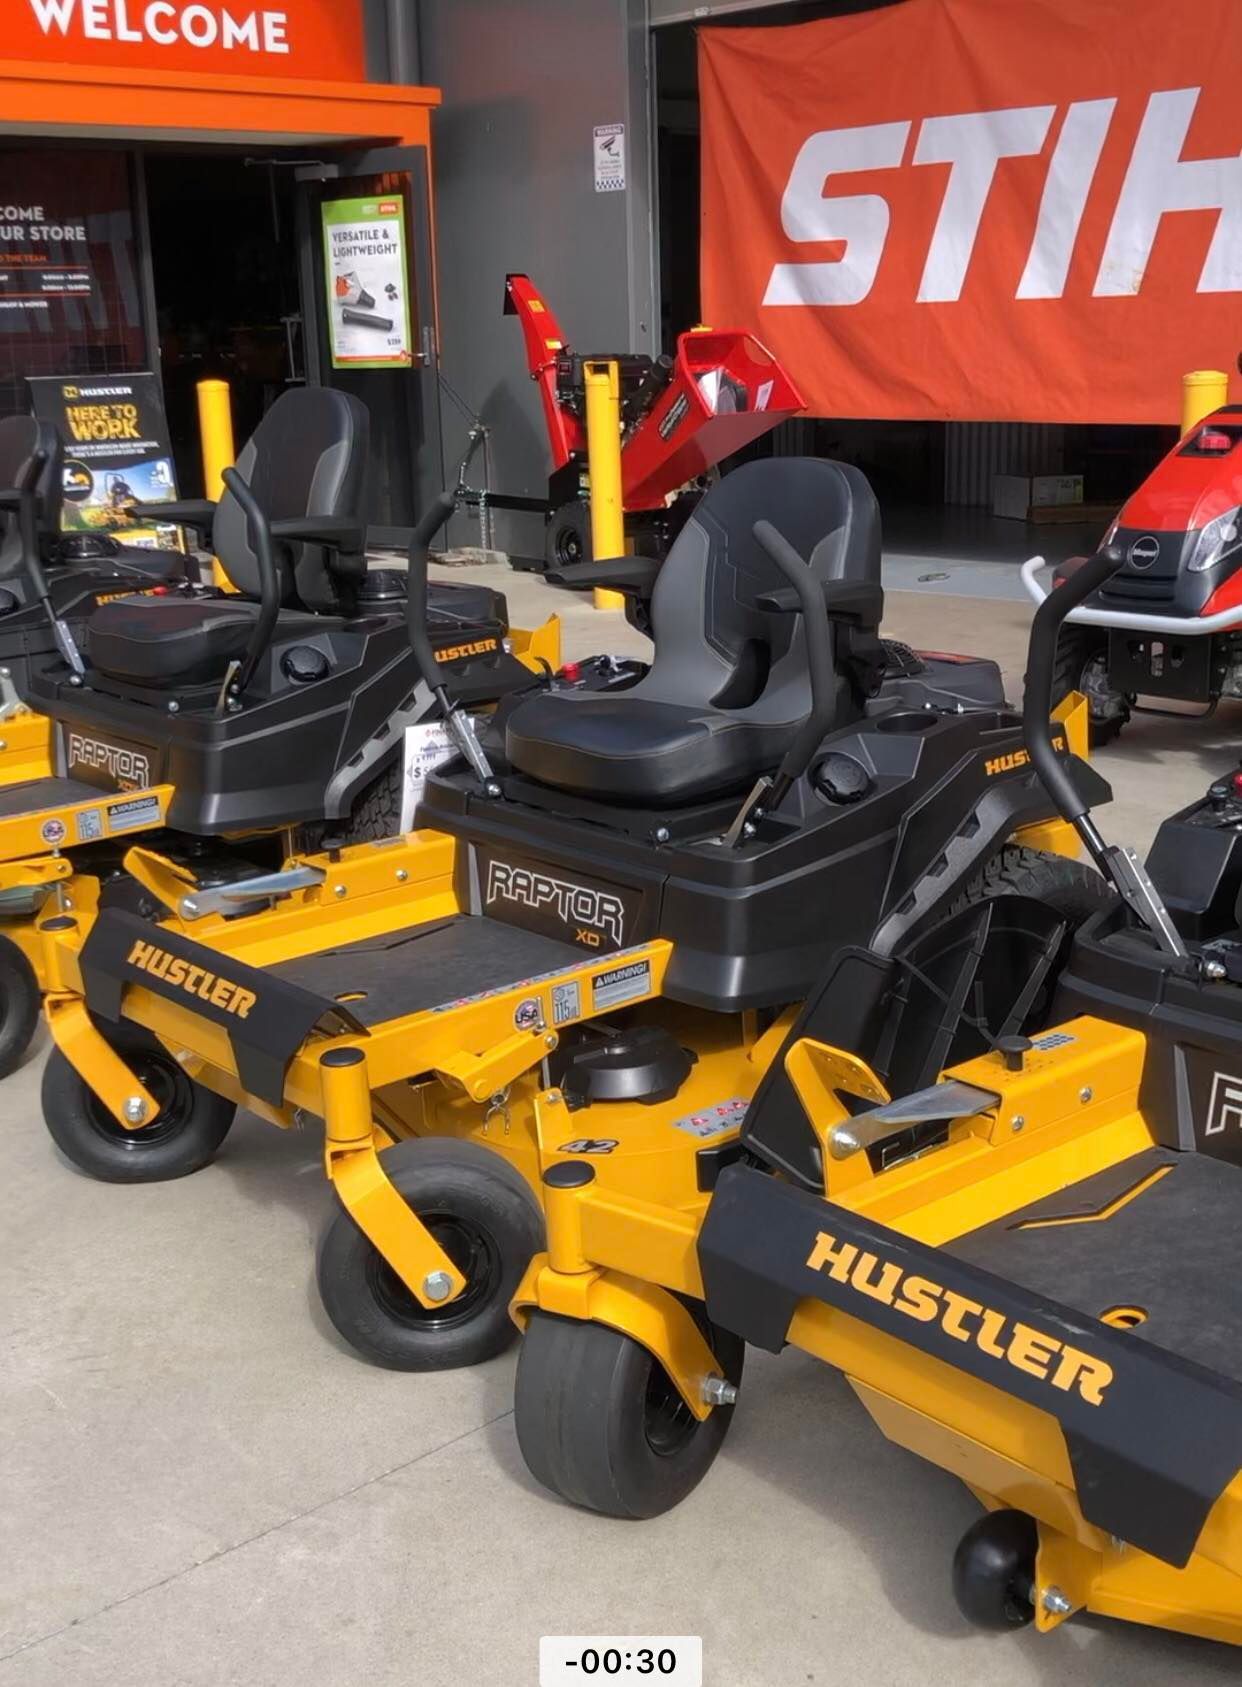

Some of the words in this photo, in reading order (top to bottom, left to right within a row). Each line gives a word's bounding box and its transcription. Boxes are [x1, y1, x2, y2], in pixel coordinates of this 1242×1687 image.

[27, 0, 289, 53] WELCOME
[762, 87, 1242, 306] STIH
[30, 226, 86, 241] STORE
[332, 229, 379, 242] VERSATILE
[382, 229, 389, 240] &
[333, 243, 397, 258] LIGHTWEIGHT
[79, 386, 133, 397] HUSTLER
[110, 404, 137, 419] TO
[69, 418, 141, 441] WORK
[434, 639, 497, 663] USTLER
[68, 733, 149, 790] RAPTOR
[984, 736, 1064, 776] HUSR
[487, 860, 624, 947] RAPTOR
[575, 928, 600, 946] XD
[127, 940, 257, 1019] HUSTLER
[557, 1139, 619, 1153] 42
[806, 1231, 1114, 1407] HUSTLER
